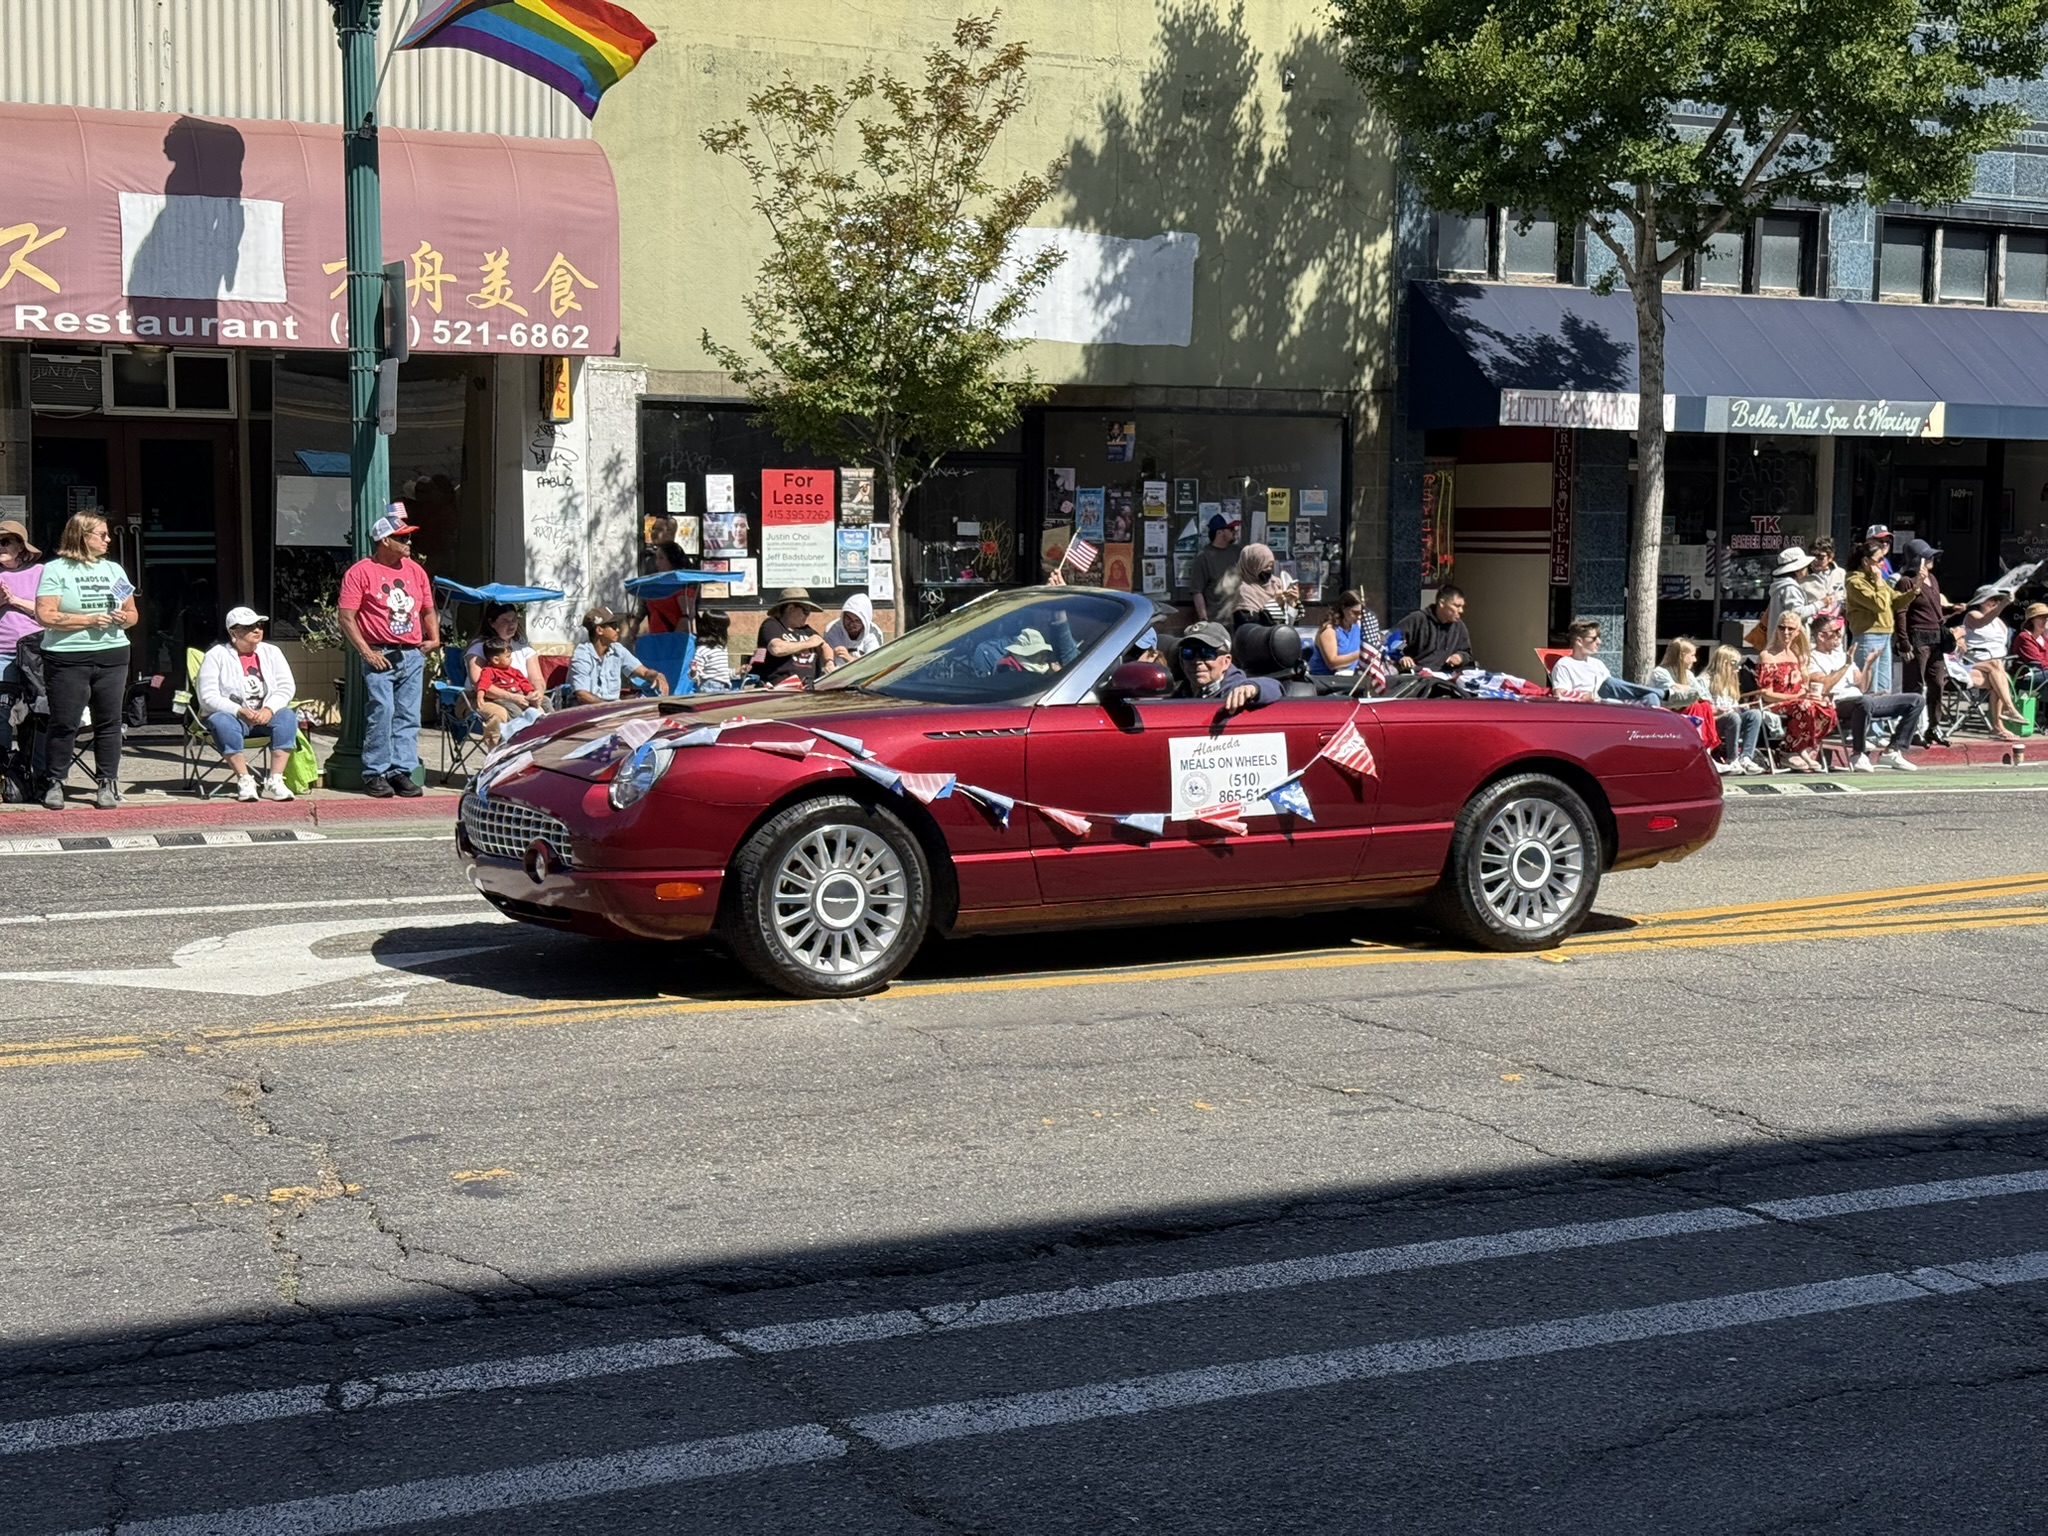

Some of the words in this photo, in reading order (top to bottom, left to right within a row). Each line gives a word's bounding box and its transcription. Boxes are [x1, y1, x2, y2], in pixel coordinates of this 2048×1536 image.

[15, 304, 300, 340] Restaurant
[432, 319, 590, 349] 521-6862
[1506, 396, 1560, 424] LITTLE
[1731, 400, 1779, 428] Bella
[1779, 401, 1818, 430] Nail
[1820, 406, 1850, 434] Spa
[1853, 404, 1867, 431] &
[1726, 457, 1812, 483] BARBER
[784, 473, 814, 487] For
[773, 490, 824, 505] Lease
[1738, 487, 1798, 514] SHOP
[767, 510, 830, 520] 415.395.7262
[1751, 516, 1781, 534] TK
[766, 533, 791, 541] Justin
[792, 533, 811, 541] Choi
[1731, 534, 1761, 549] BARBER
[1762, 535, 1783, 549] SHOP
[766, 553, 781, 561] Jeff
[1192, 737, 1241, 757] Alameda
[1180, 757, 1216, 771] MEALS
[1217, 756, 1234, 768] ON
[1234, 754, 1278, 768] WHEELS
[1229, 772, 1260, 787] (510)
